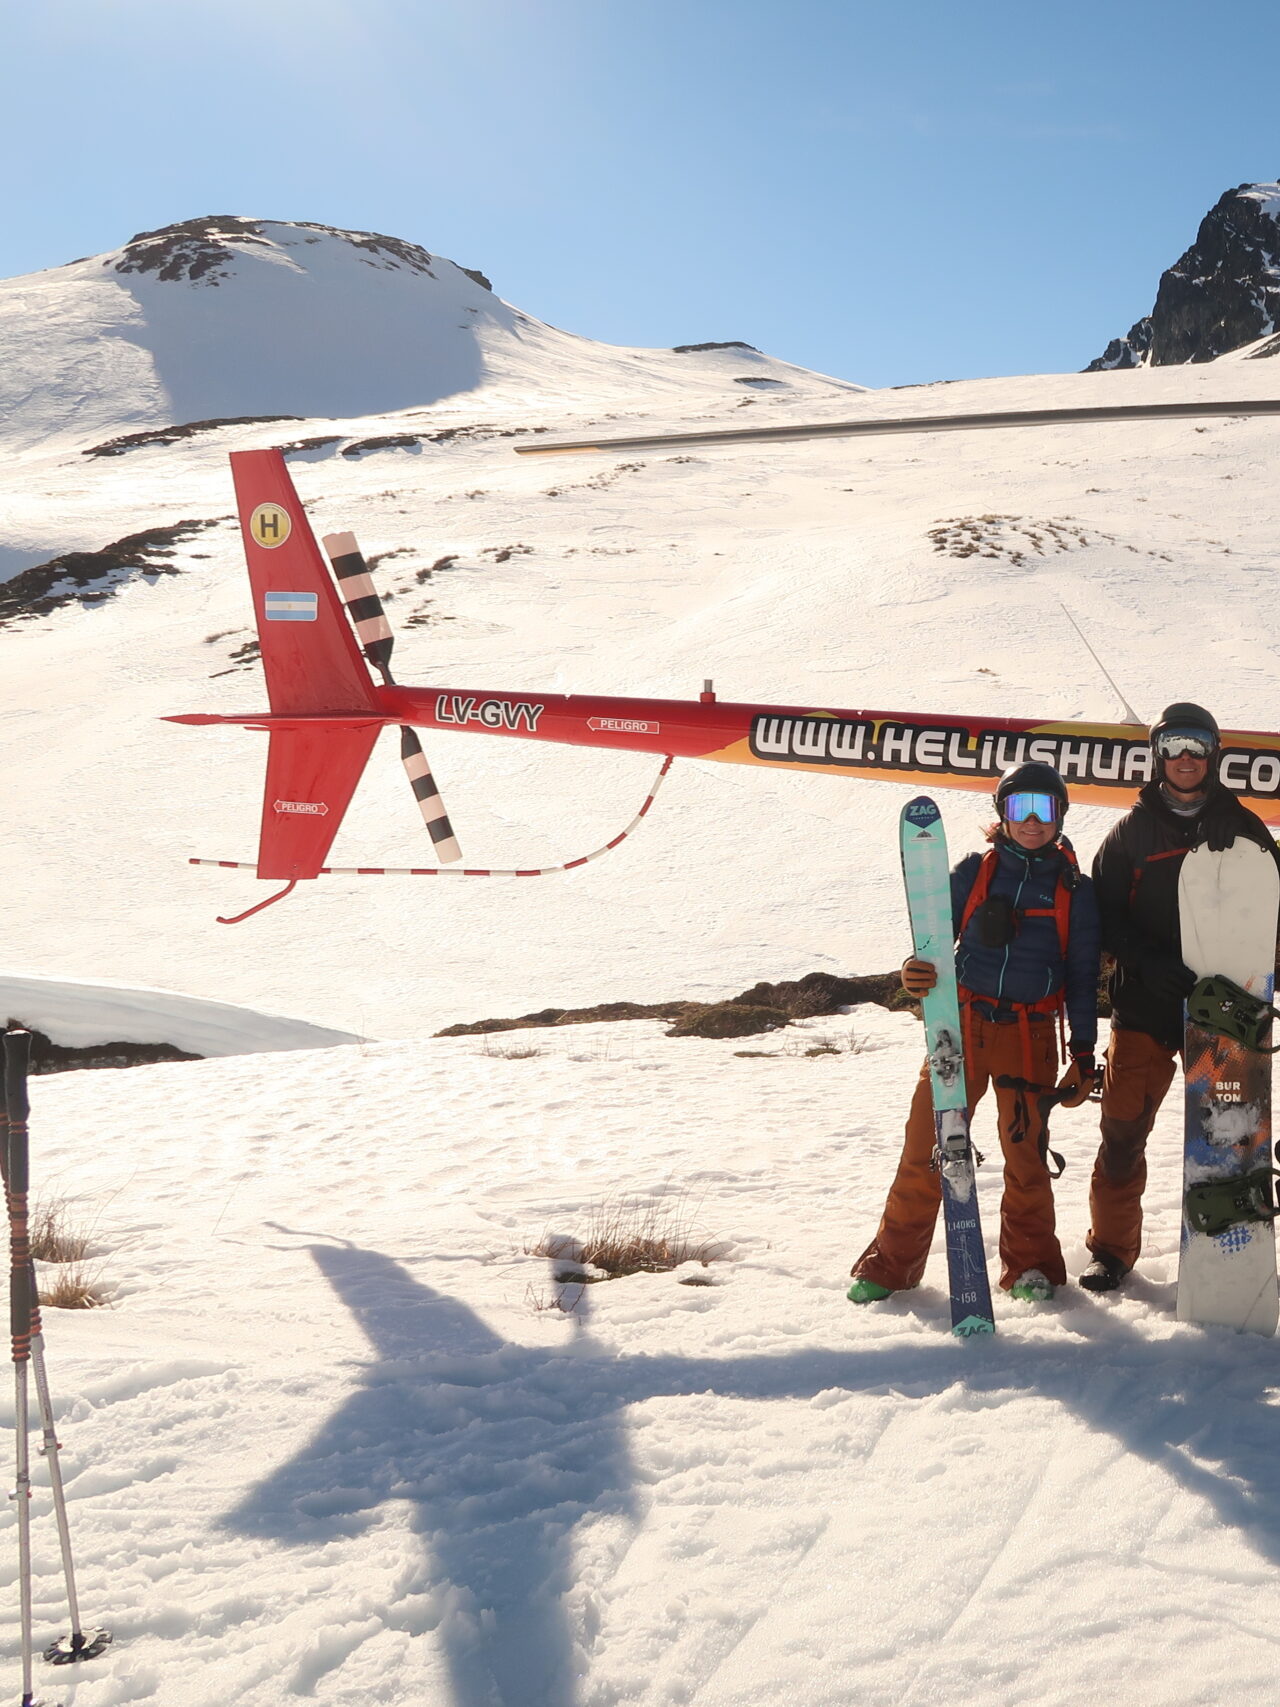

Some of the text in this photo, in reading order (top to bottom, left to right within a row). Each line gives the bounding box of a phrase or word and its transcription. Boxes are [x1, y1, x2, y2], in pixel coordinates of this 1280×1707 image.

[261, 514, 278, 538] H
[436, 695, 544, 731] LV-GVY
[600, 719, 648, 732] PELIGRO
[281, 803, 319, 813] PELIGRO
[909, 804, 937, 817] ZAG
[1215, 1081, 1241, 1091] BUR
[1215, 1093, 1242, 1103] TON
[961, 1291, 977, 1304] 158
